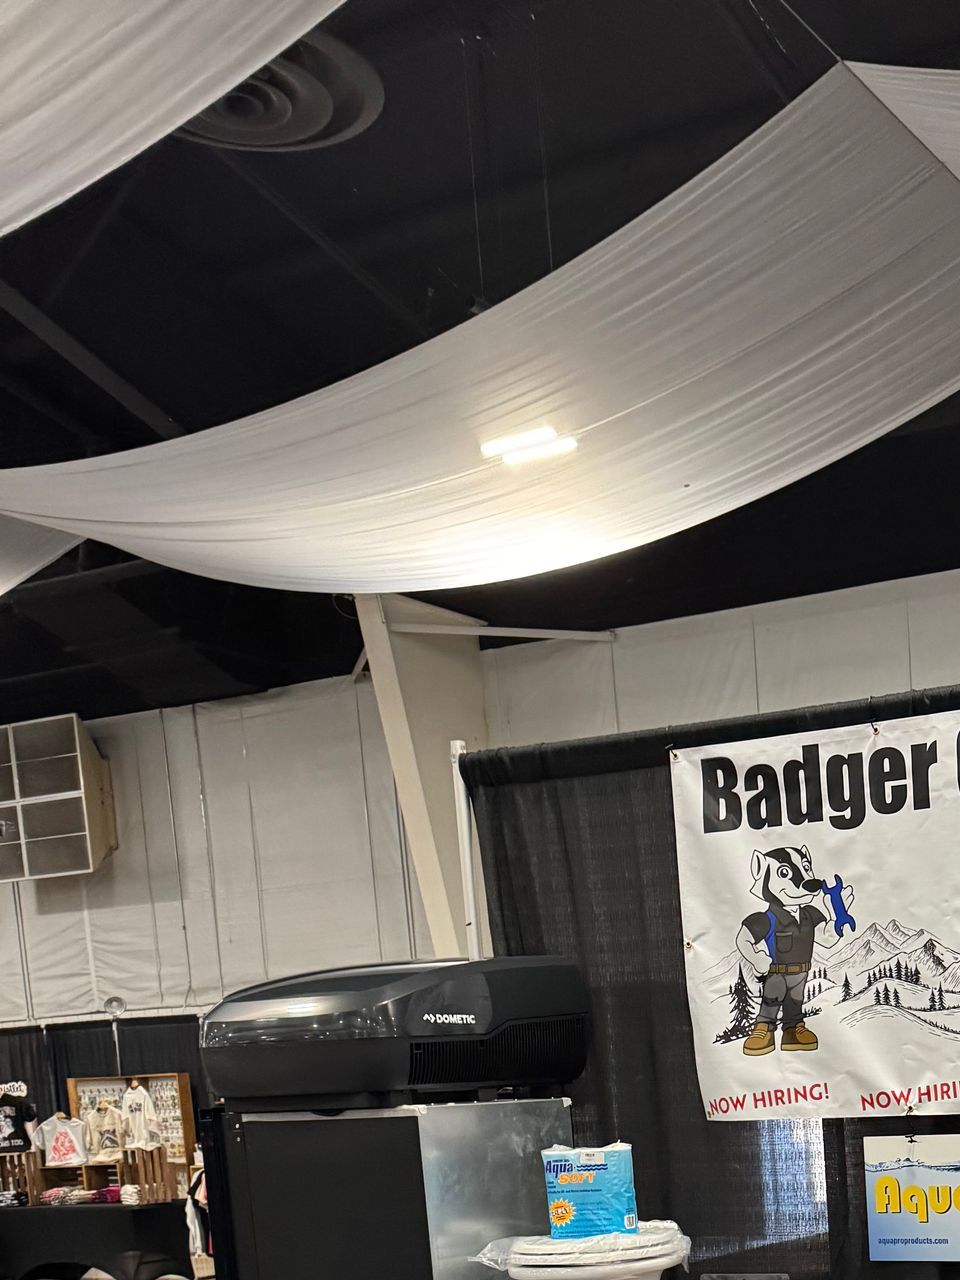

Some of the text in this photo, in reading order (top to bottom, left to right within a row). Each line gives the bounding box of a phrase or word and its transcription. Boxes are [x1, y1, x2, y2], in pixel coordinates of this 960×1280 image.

[701, 740, 937, 833] Badger
[436, 1014, 476, 1024] DOMETIC
[710, 1082, 829, 1114] NOW HIRING!
[860, 1087, 912, 1111] NOW
[878, 1237, 949, 1246] aquaproproducts.com
